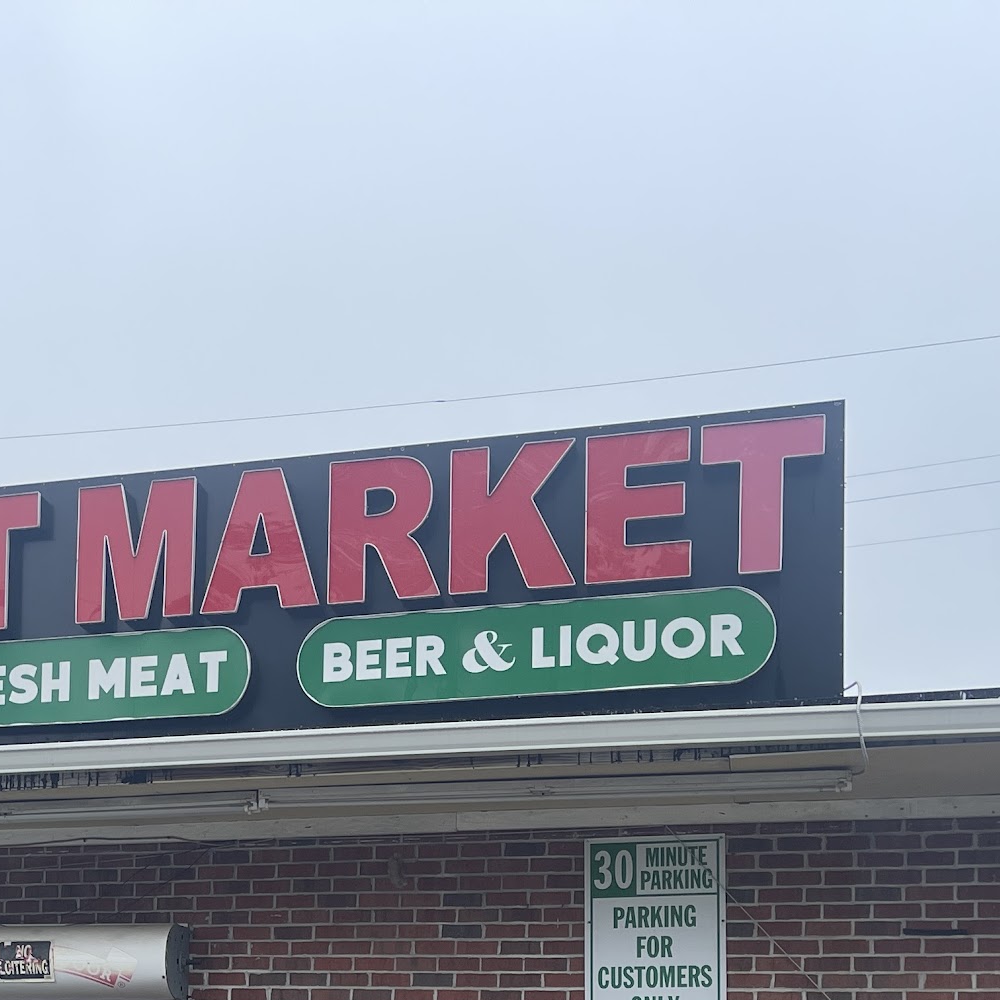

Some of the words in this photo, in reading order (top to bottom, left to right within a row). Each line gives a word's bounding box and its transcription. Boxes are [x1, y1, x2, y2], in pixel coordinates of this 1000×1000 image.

[74, 414, 827, 625] MARKET
[322, 635, 447, 684] BEER
[461, 628, 517, 674] &
[530, 613, 746, 669] LIQUOR
[87, 650, 228, 700] MEAT
[645, 845, 708, 868] MINUTE
[593, 849, 634, 890] 30
[640, 868, 713, 891] PARKING
[613, 904, 697, 929] PARKING
[15, 944, 33, 959] NO
[636, 935, 673, 958] FOR
[0, 959, 50, 975] LOITERING
[597, 964, 713, 989] CUSTOMERS
